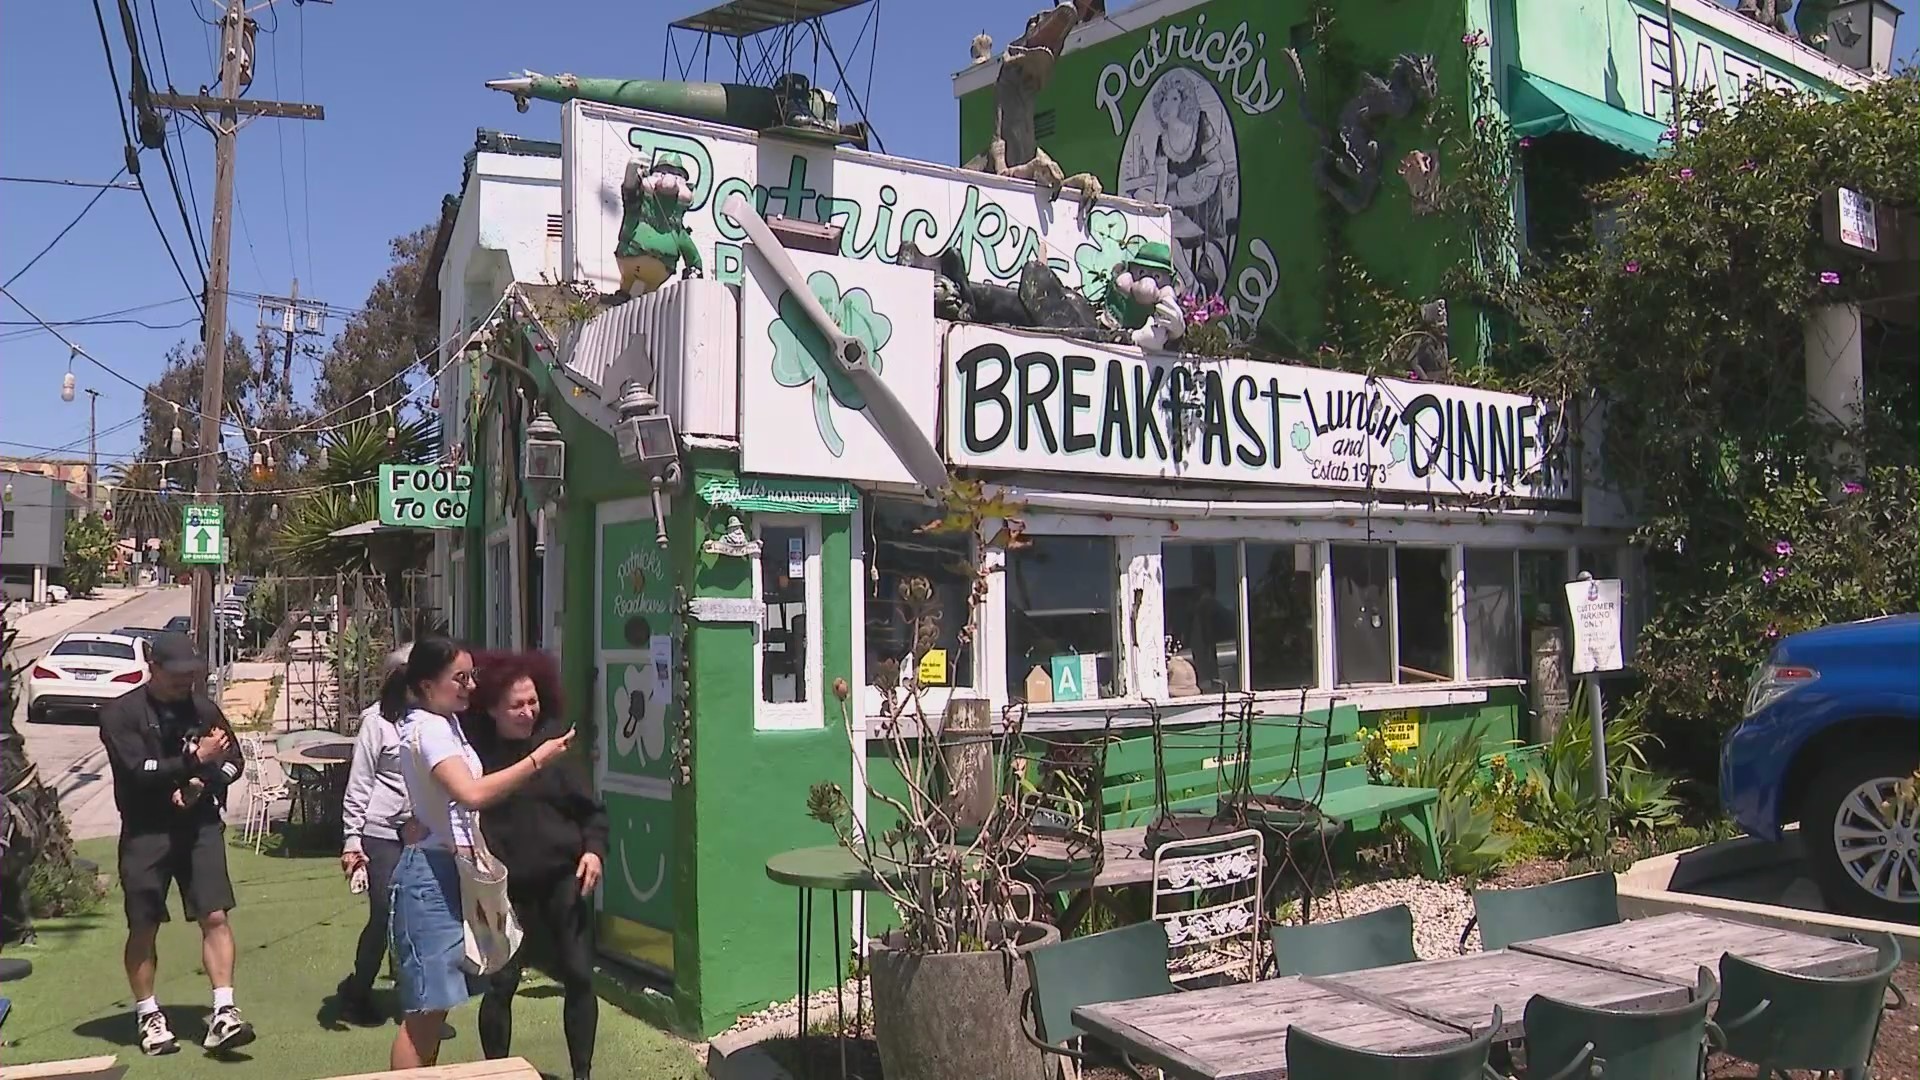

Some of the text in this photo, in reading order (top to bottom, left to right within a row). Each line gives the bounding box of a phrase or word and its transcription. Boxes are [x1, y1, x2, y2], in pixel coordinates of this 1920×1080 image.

[1332, 434, 1366, 458] and
[390, 469, 473, 494] FOOD
[767, 488, 837, 504] ROADHOUSE
[1577, 602, 1615, 613] CUSTOMER
[1584, 620, 1604, 628] ONLY
[1058, 665, 1078, 695] A
